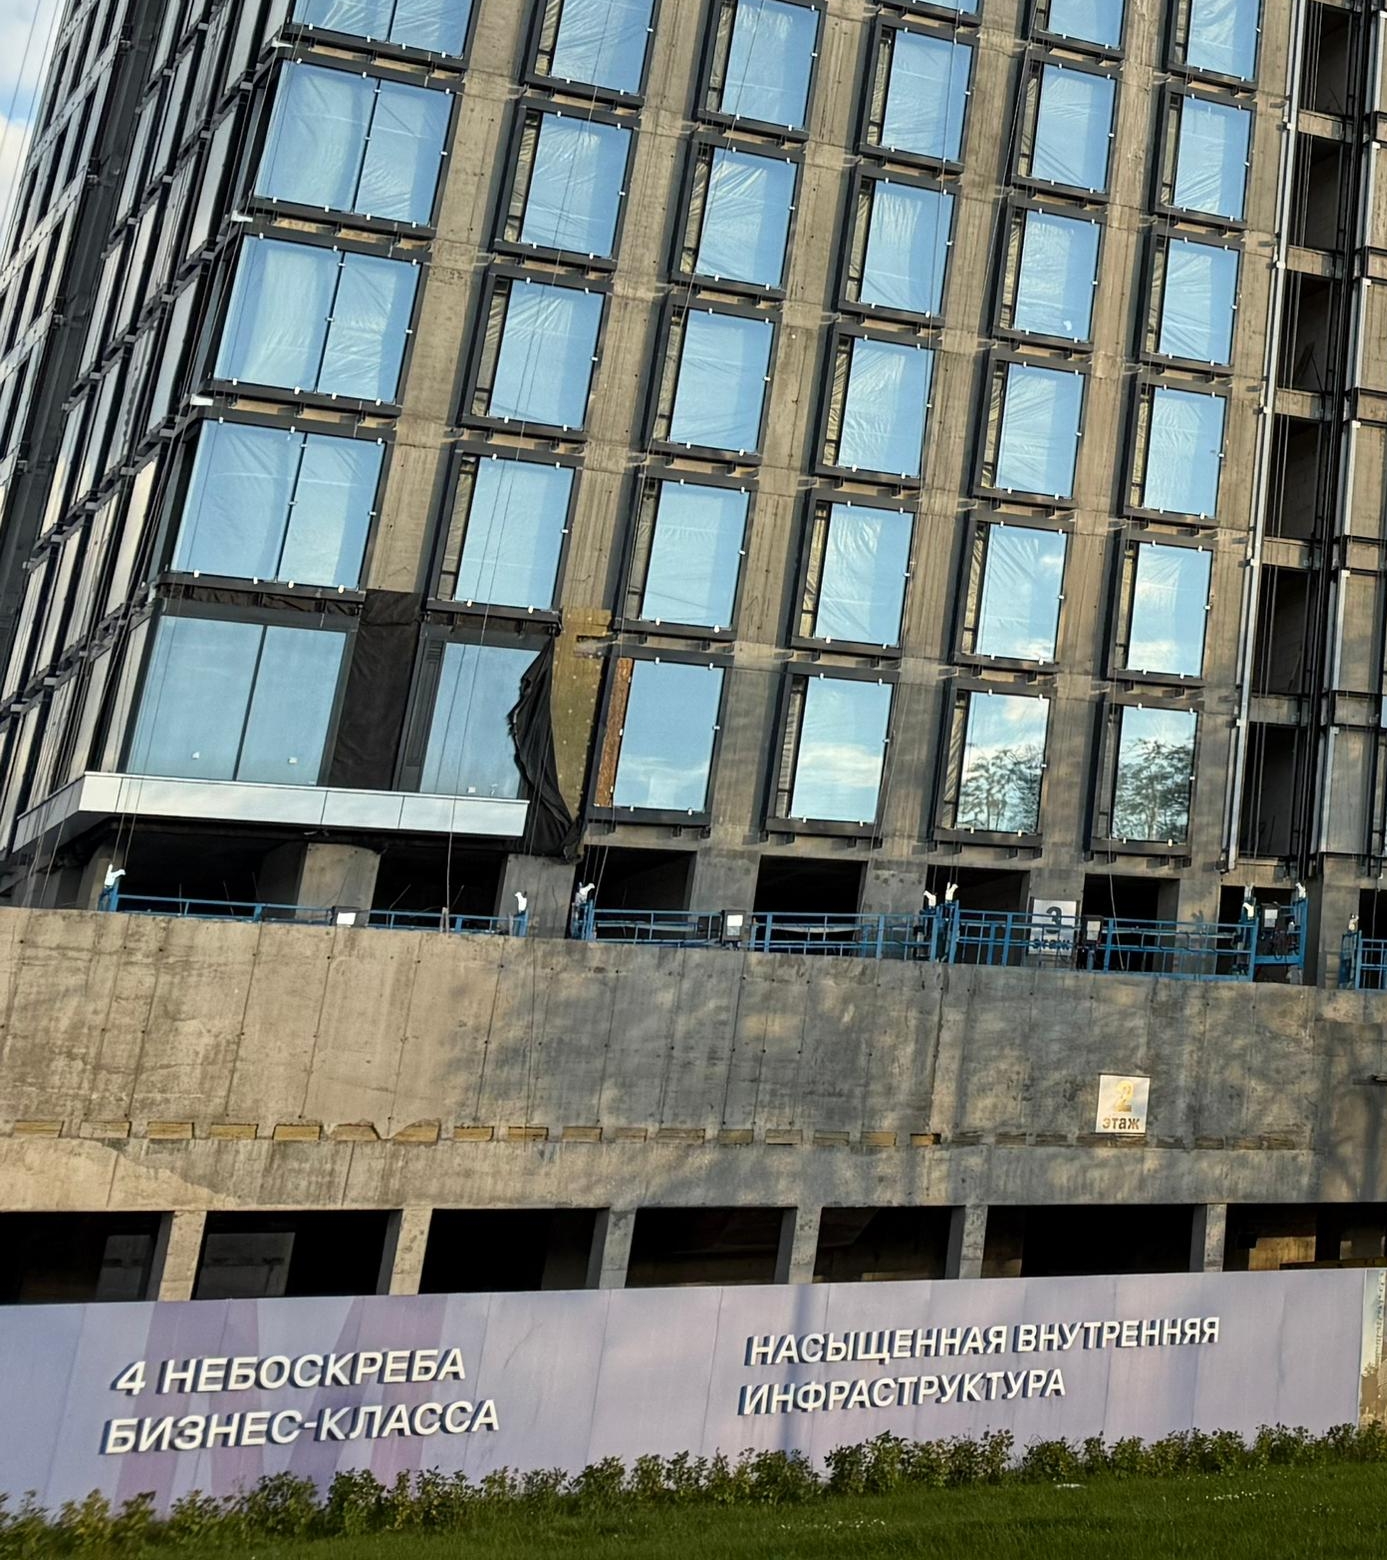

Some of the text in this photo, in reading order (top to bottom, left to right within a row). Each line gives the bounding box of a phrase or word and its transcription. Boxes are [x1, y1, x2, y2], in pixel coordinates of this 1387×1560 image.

[1046, 906, 1062, 934] 3
[1115, 1081, 1133, 1112] 2
[1102, 1118, 1140, 1130] этаж
[744, 1316, 1220, 1367] НАСЫЩЕННАЯ ВНУТРЕННЯЯ
[112, 1347, 466, 1396] 4 НЕБОСКРЕБА
[738, 1368, 1066, 1417] ИНФРАСТРУКТУРА
[101, 1400, 500, 1455] БИЗНЕС-КЛАССА
